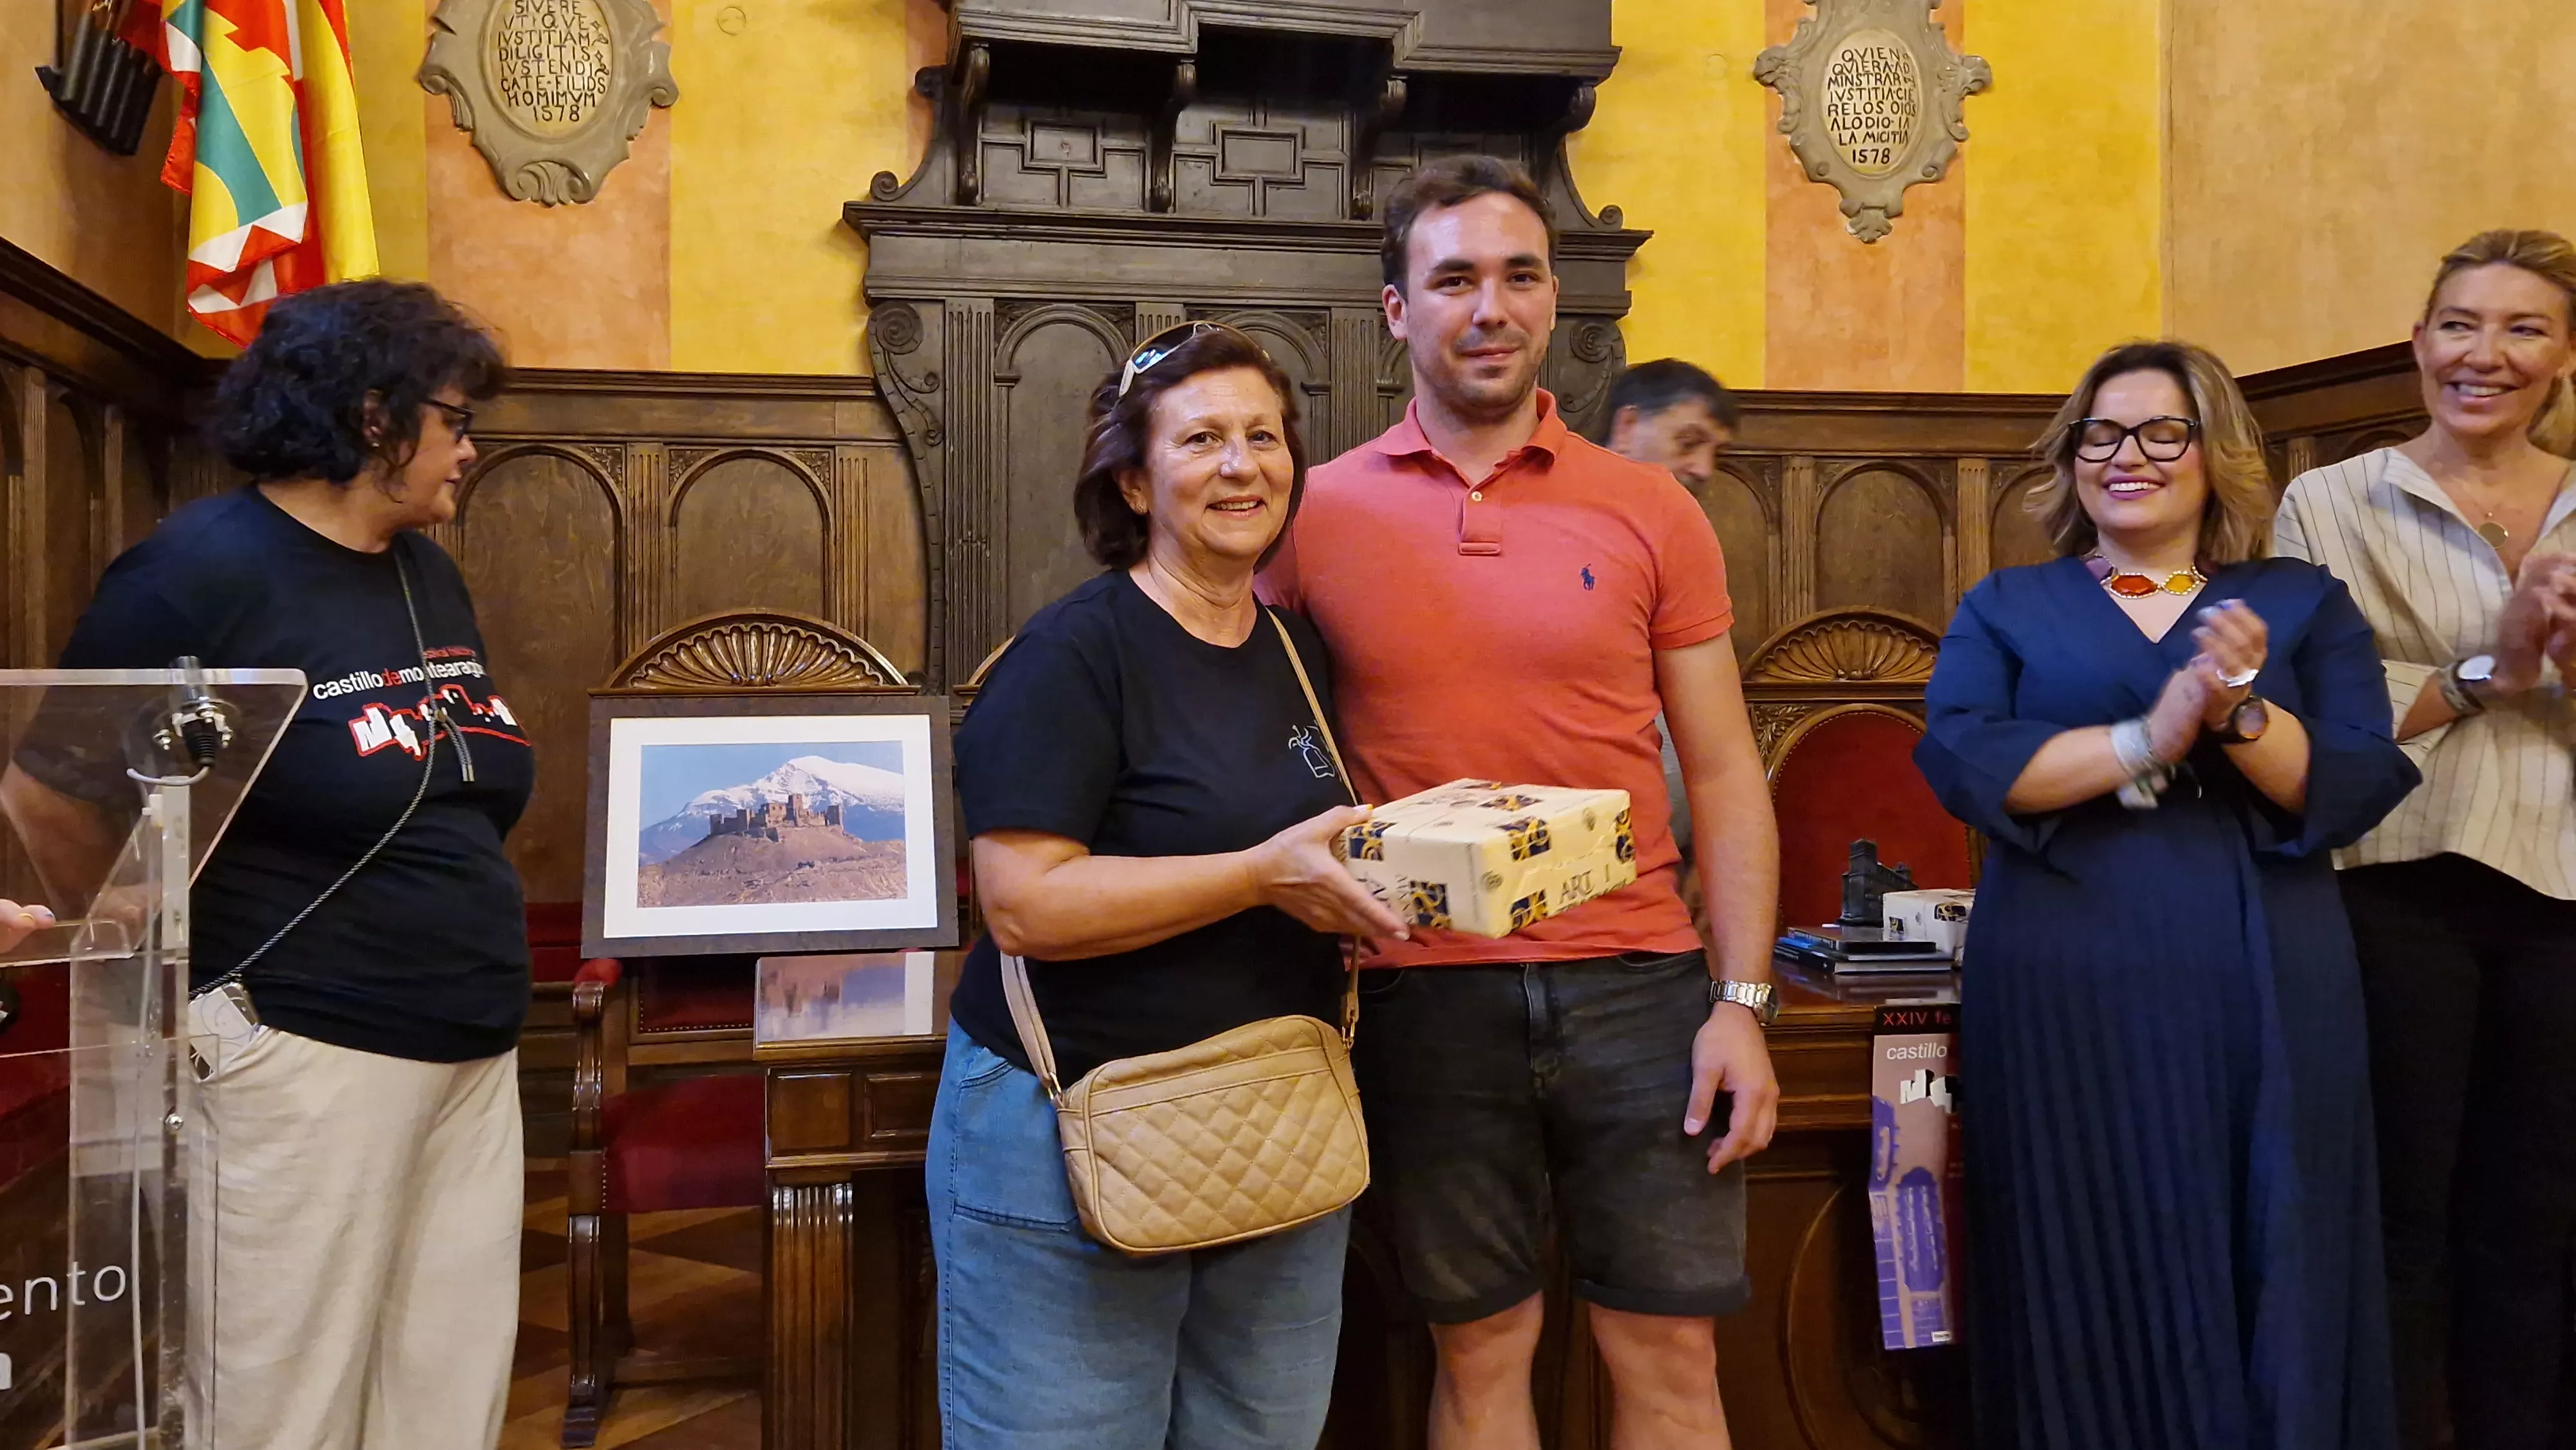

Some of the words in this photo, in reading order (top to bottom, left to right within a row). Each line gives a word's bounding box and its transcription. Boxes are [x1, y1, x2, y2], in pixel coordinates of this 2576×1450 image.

[533, 104, 580, 122] 1578
[1852, 147, 1891, 165] 1578
[1883, 1012, 1927, 1026] XXIV
[1886, 1041, 1947, 1060] castillo
